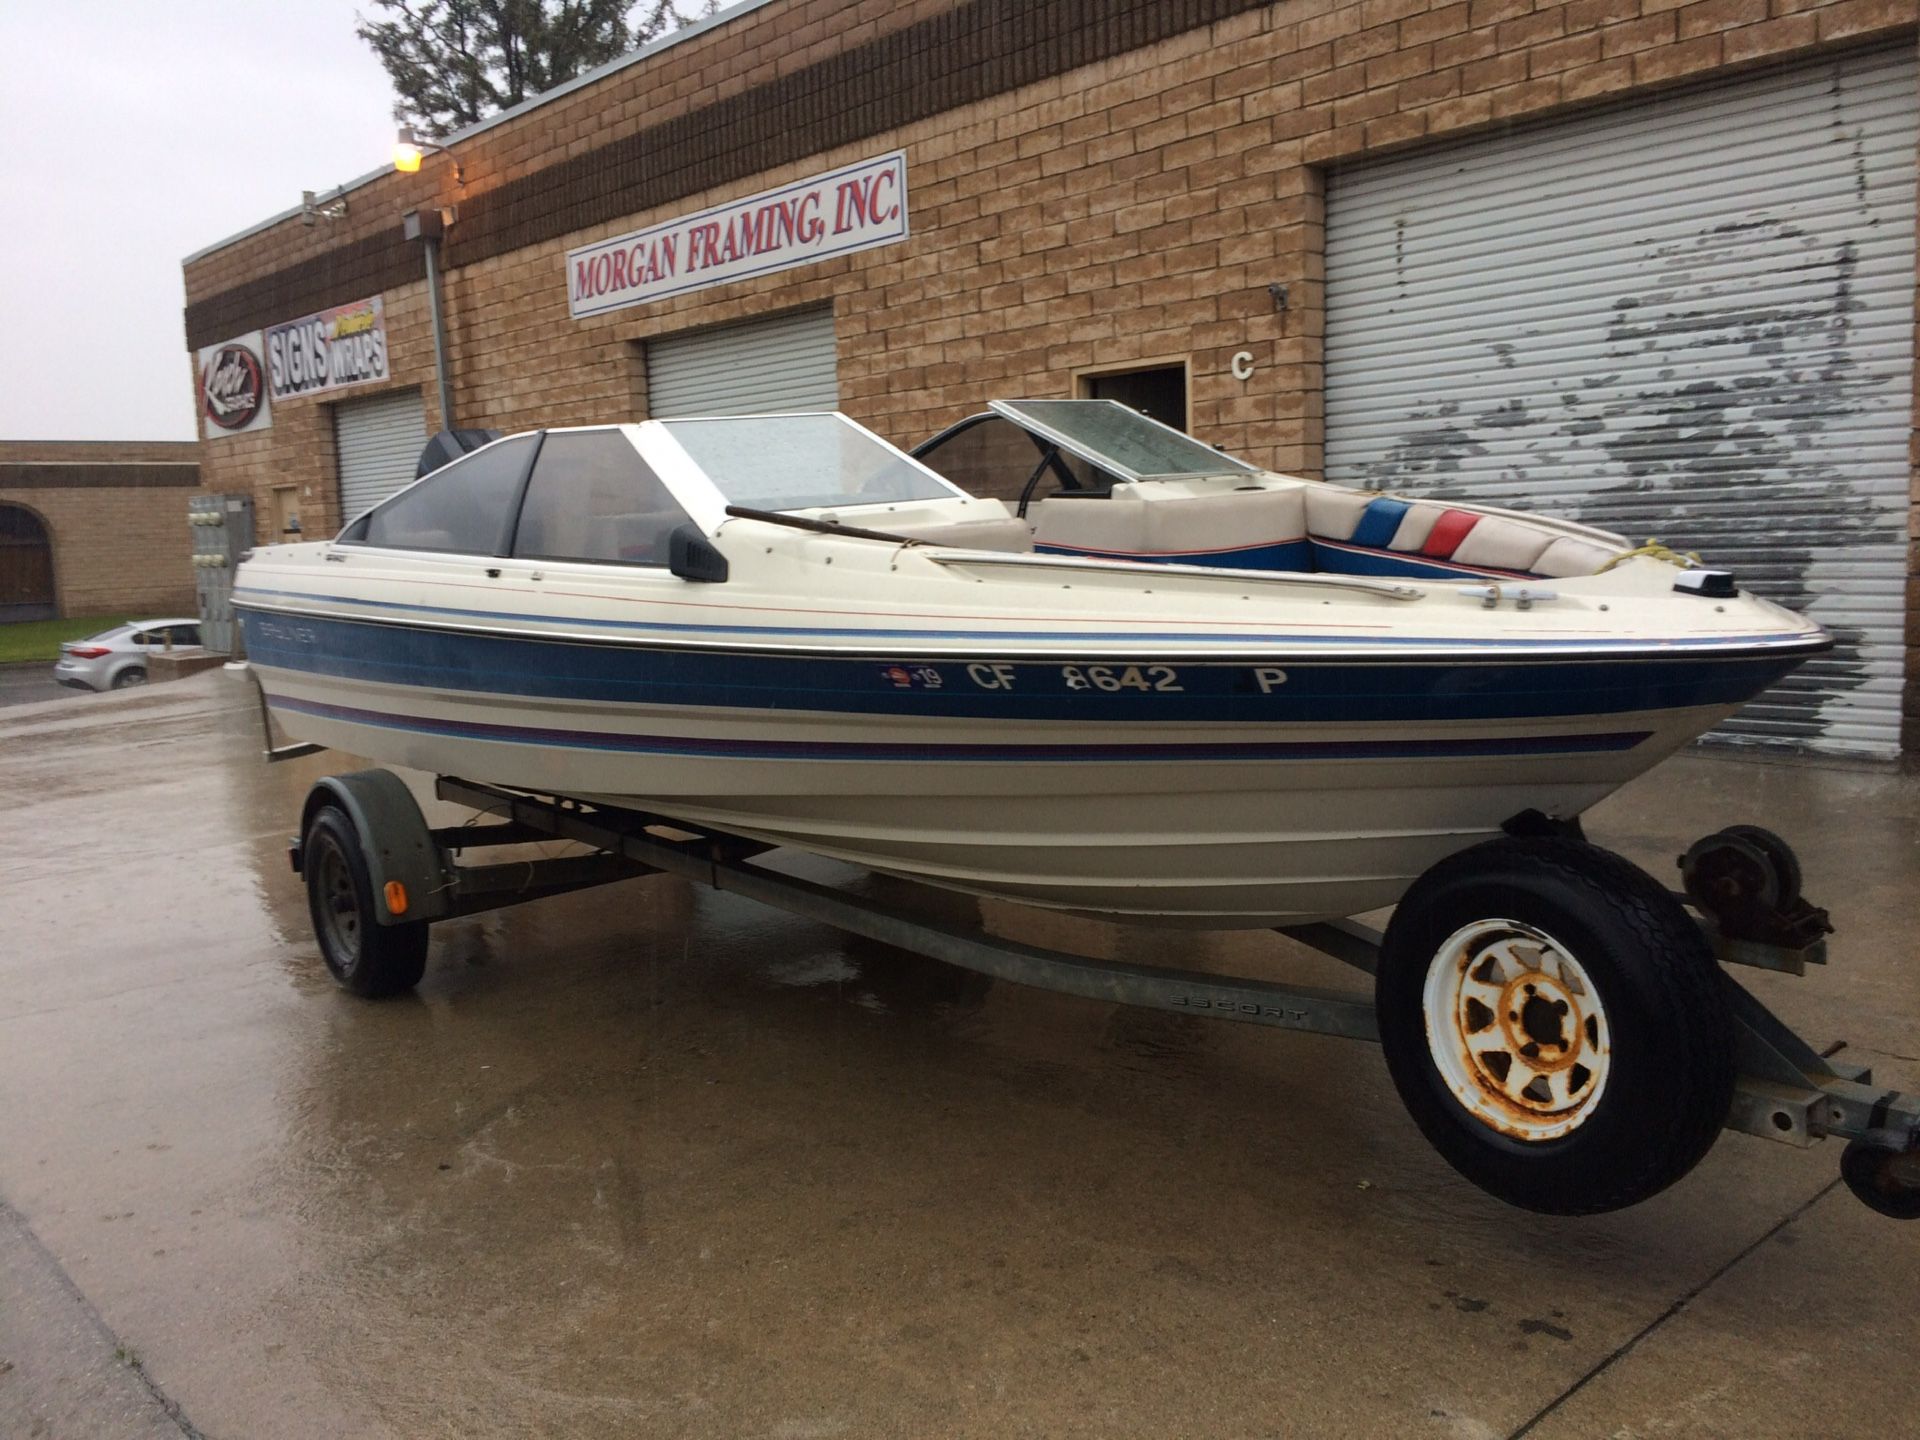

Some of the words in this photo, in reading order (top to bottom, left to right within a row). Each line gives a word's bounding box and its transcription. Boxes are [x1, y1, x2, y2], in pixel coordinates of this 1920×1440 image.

[574, 234, 679, 301] MORGAN
[685, 191, 825, 272] FRAMING,
[832, 168, 899, 235] INC.
[270, 320, 327, 393] SIGNS
[329, 330, 383, 381] WRAPS
[1231, 351, 1254, 380] C
[918, 668, 943, 684] 19
[966, 663, 1017, 690] CF
[1062, 666, 1184, 691] 8642
[1254, 668, 1288, 693] P
[1169, 995, 1308, 1020] ESCORT
